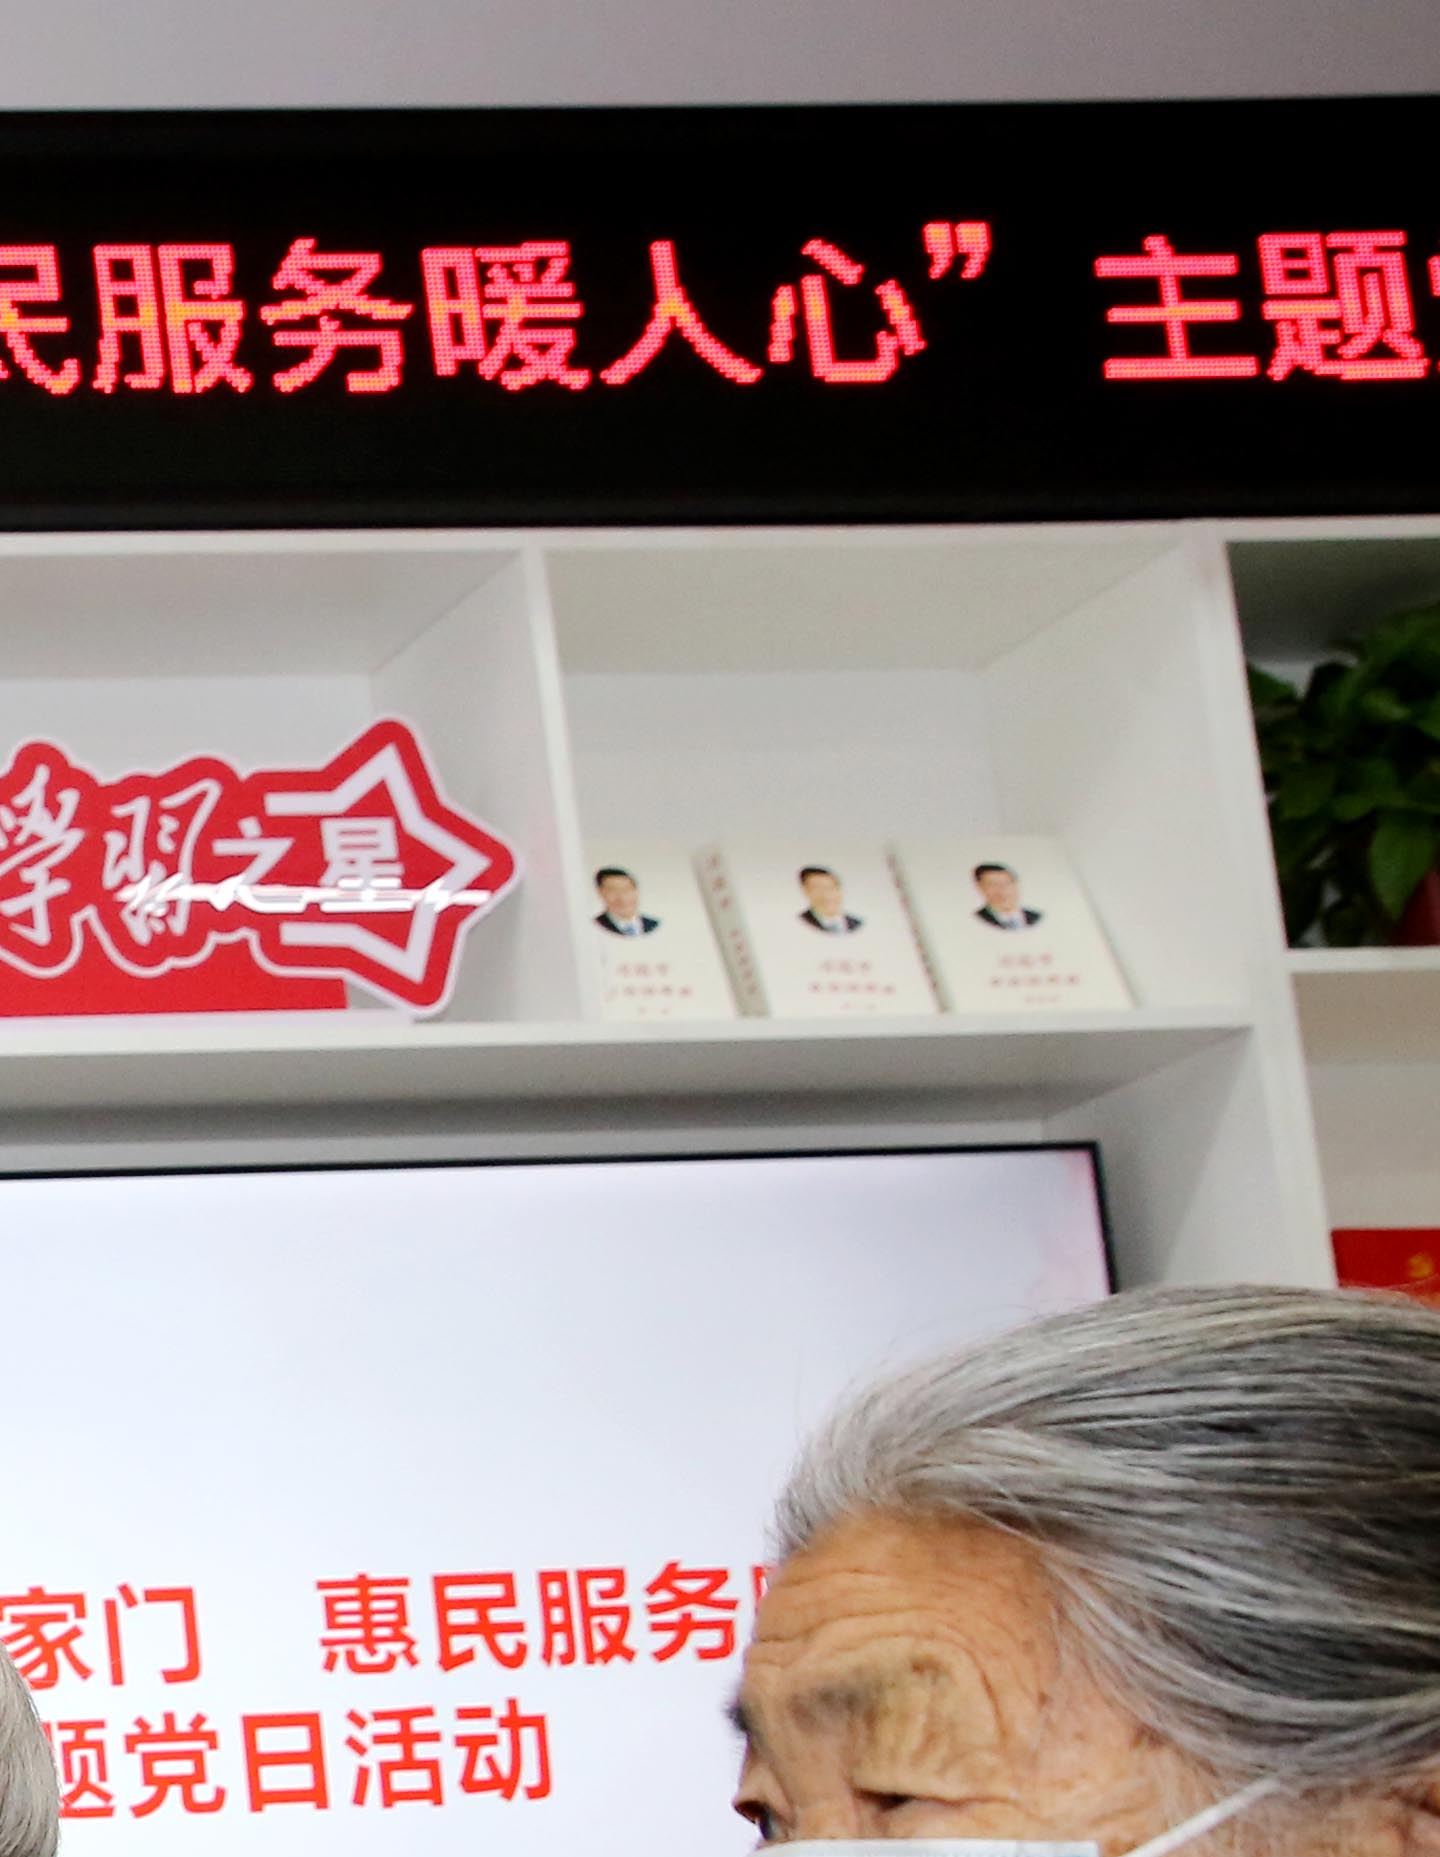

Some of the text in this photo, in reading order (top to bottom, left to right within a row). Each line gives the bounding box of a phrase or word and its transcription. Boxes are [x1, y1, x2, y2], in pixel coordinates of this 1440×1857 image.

[1092, 228, 1440, 380] 主题
[318, 1561, 768, 1676] 惠民服务
